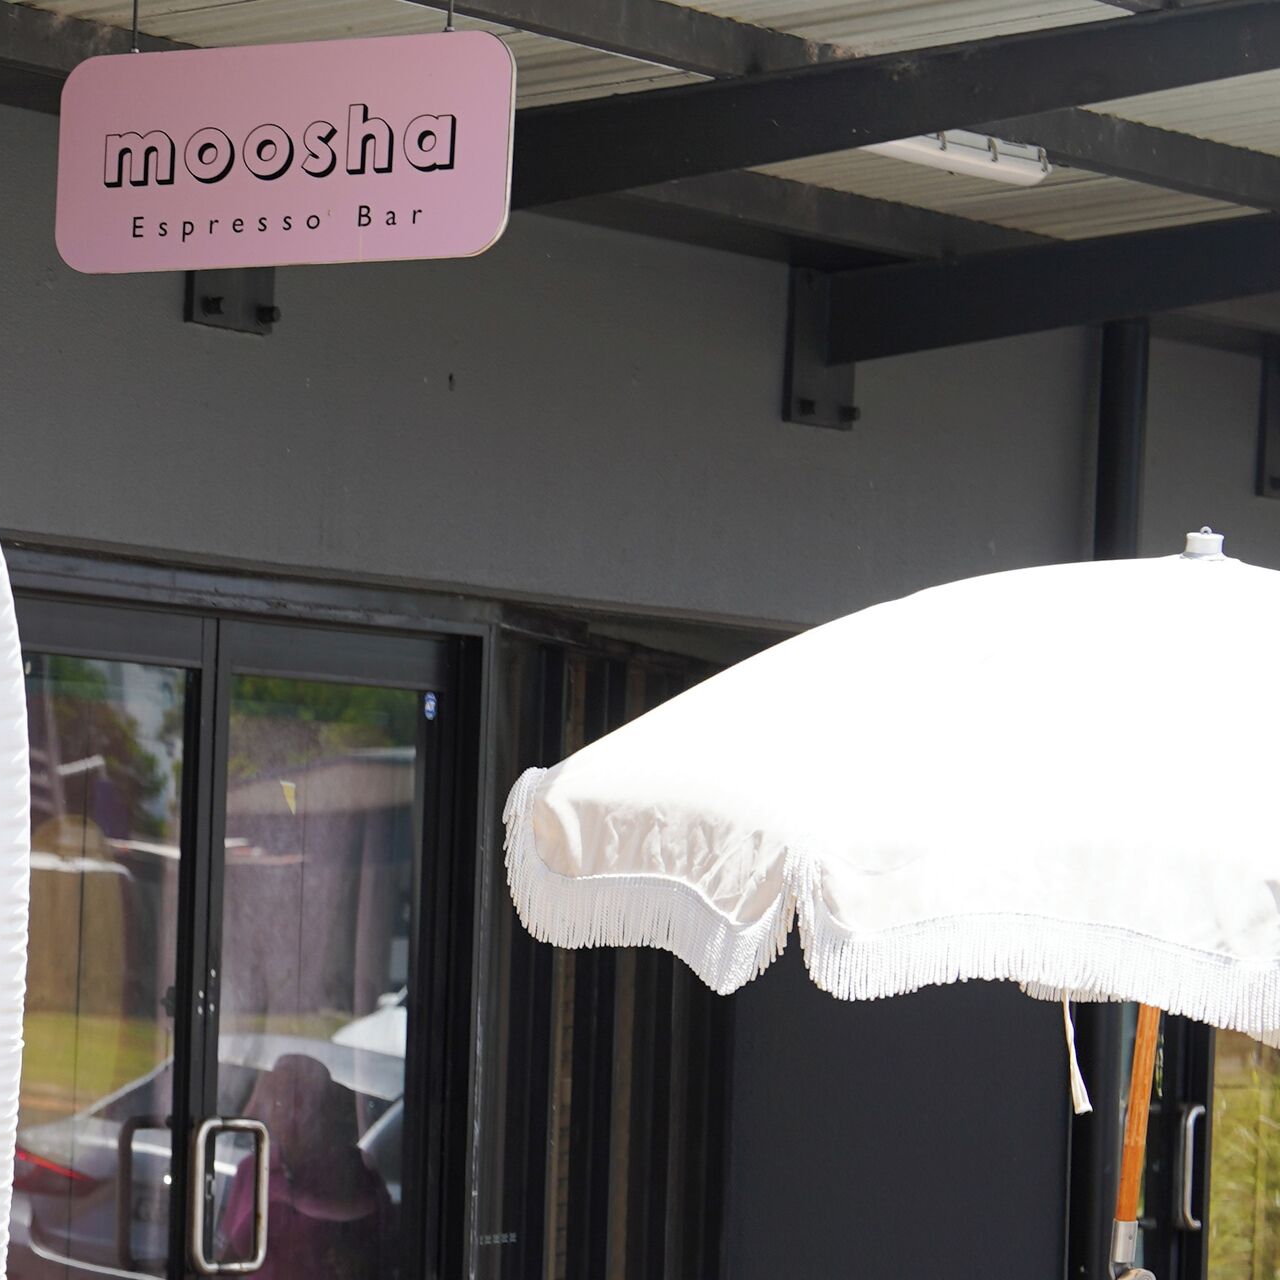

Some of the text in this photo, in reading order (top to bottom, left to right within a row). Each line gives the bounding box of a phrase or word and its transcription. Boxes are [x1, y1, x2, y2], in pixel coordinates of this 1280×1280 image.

[104, 104, 456, 188] moosha
[132, 204, 423, 243] Espresso Bar
